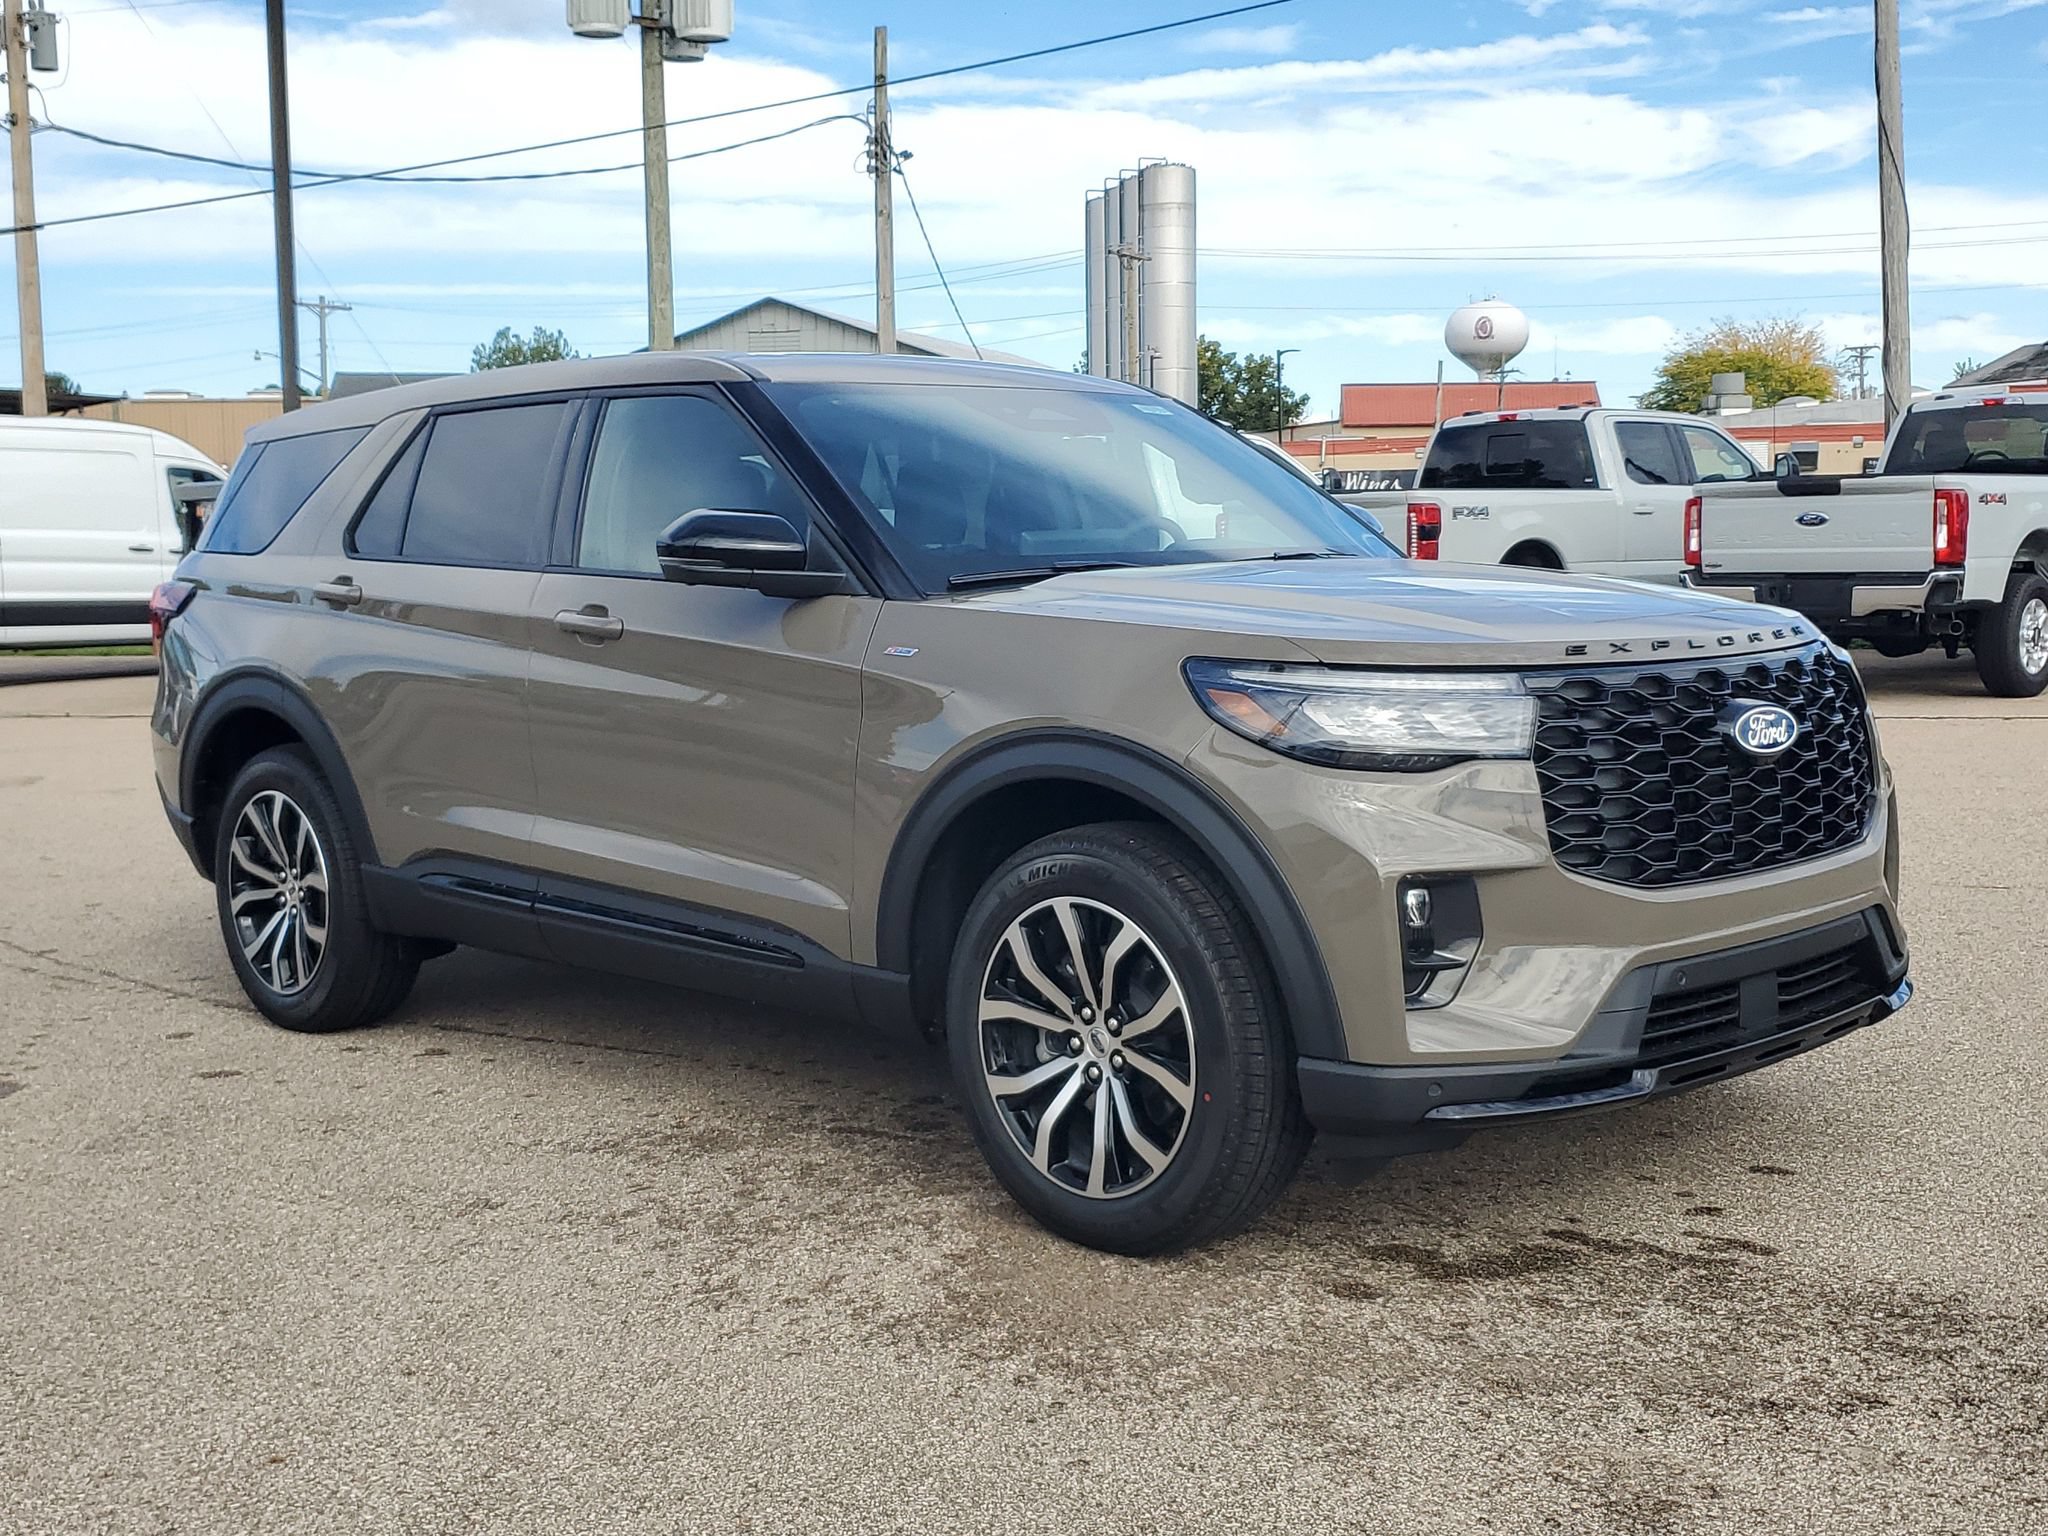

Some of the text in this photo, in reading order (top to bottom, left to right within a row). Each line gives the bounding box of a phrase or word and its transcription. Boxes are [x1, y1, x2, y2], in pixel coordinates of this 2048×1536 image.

[1345, 472, 1402, 490] Wines
[1452, 506, 1489, 520] FX4
[1565, 626, 1804, 656] EXPLORER
[1748, 713, 1788, 746] Ford
